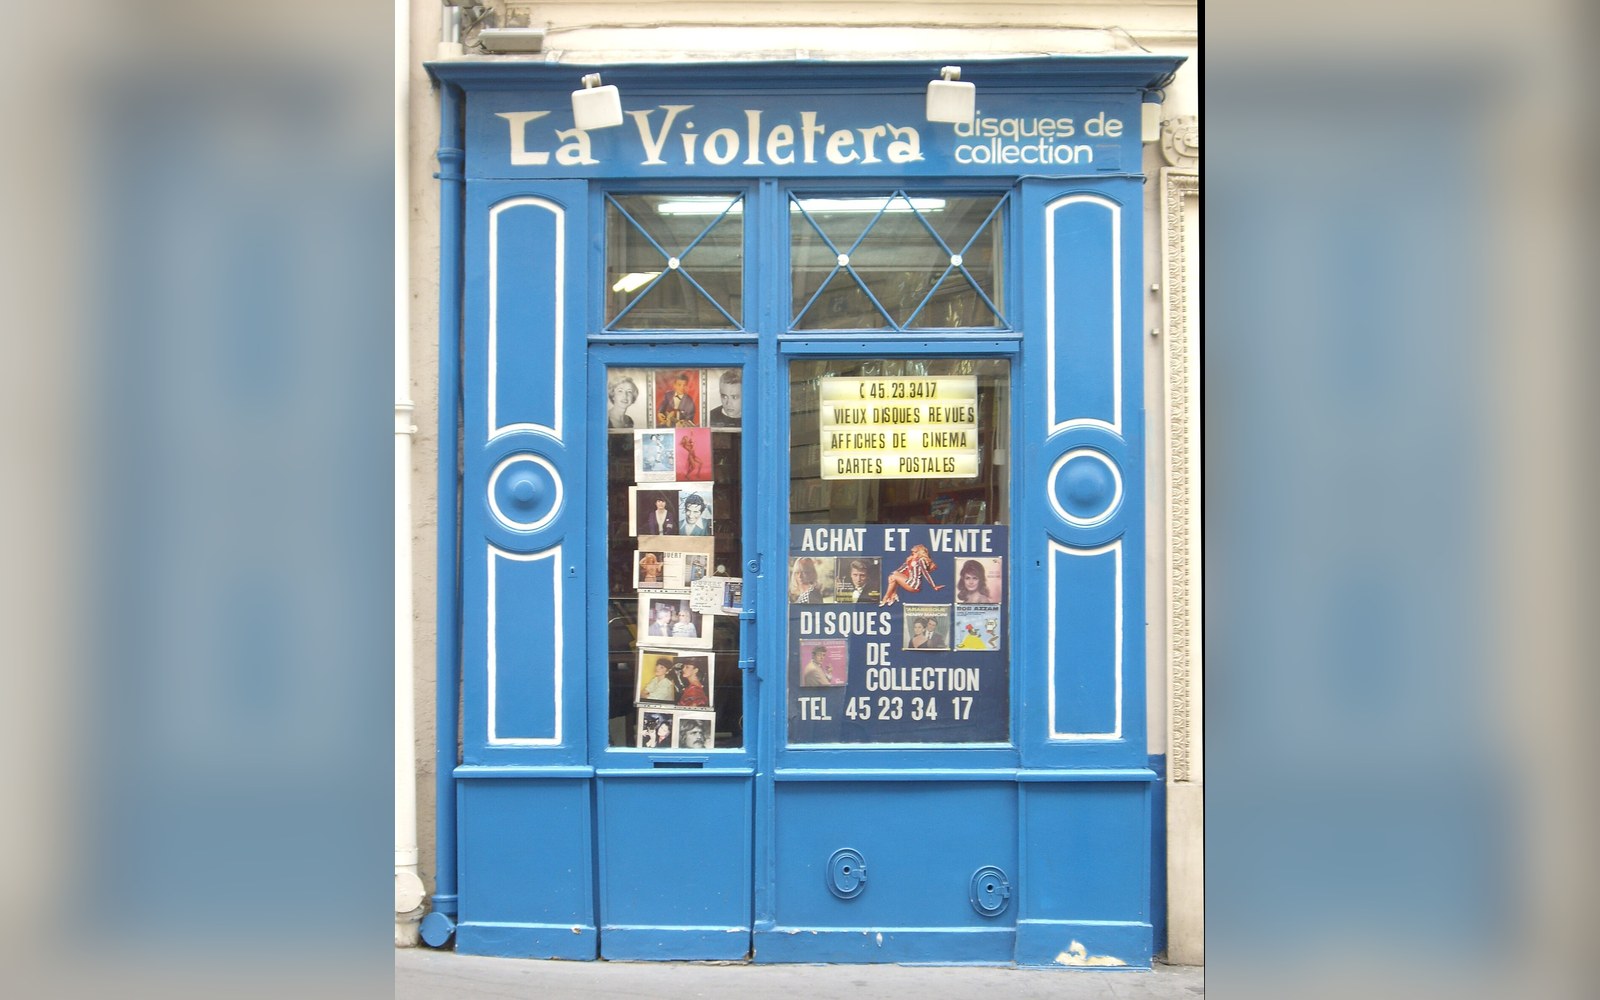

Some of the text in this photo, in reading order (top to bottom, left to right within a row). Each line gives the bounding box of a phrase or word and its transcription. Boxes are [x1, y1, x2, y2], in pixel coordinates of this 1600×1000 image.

[494, 104, 926, 165] La Violetera
[954, 110, 1123, 142] disques de
[954, 137, 1093, 165] collection
[833, 406, 975, 424] VIEUX DISQUES REVUES
[831, 431, 967, 449] AFFICHES DE CINEMA
[837, 456, 955, 474] CARTES POSTALES
[801, 528, 993, 553] ACHAT ET VENTE
[800, 611, 892, 638] DISQUES
[866, 642, 891, 666] DE
[865, 667, 980, 692] COLLECTION
[798, 696, 974, 721] TEL 45 23 34 17
